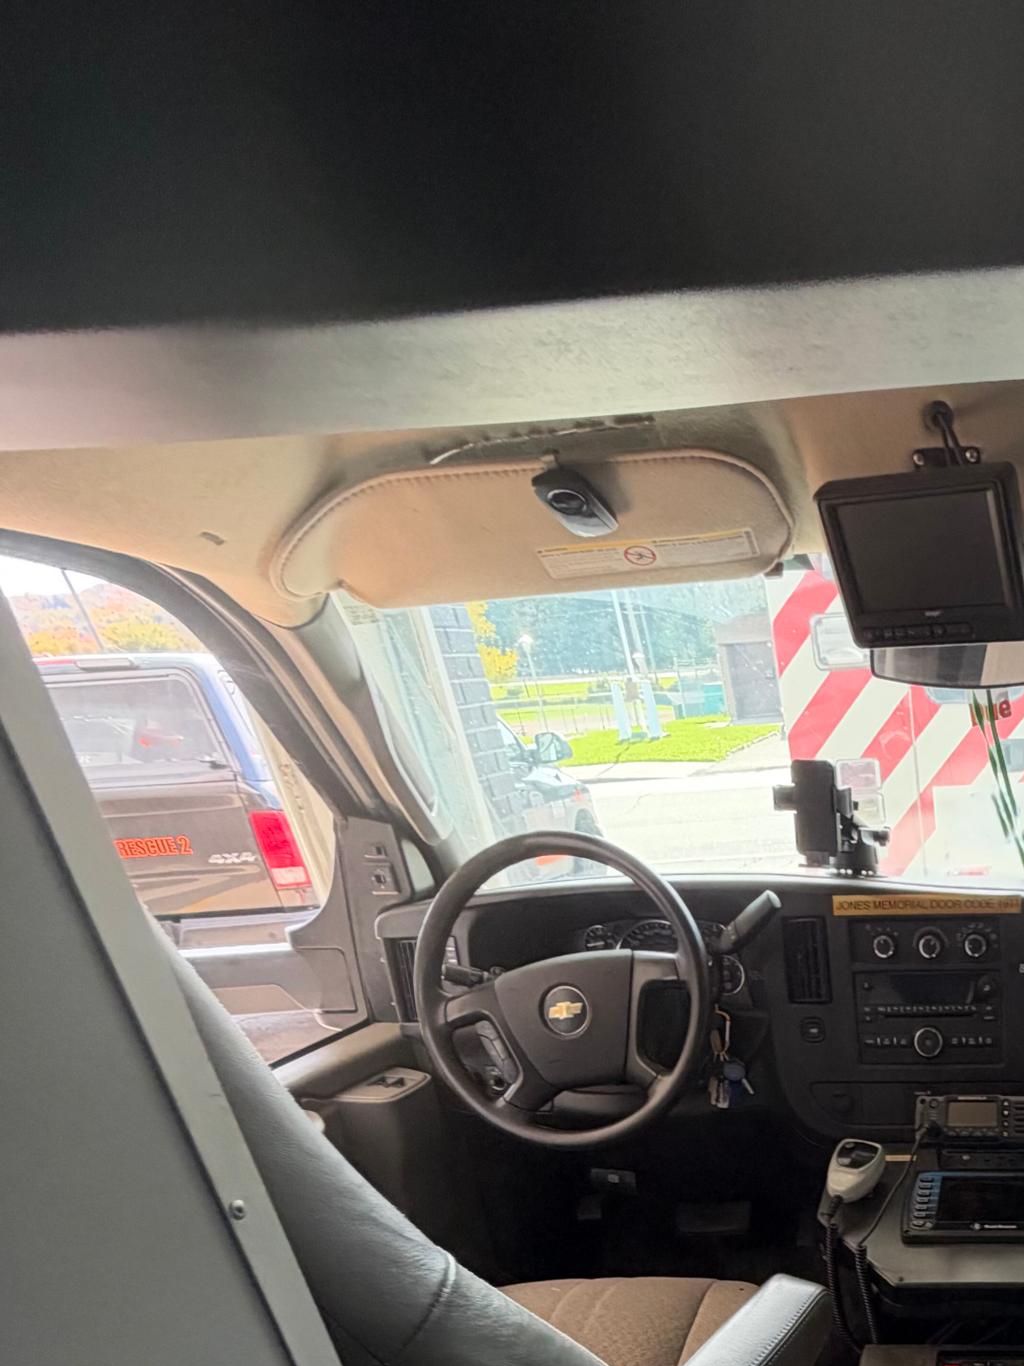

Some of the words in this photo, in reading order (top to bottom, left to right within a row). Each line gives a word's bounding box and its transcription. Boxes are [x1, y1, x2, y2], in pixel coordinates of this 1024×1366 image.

[113, 836, 178, 860] RESCUE
[175, 834, 193, 855] 2
[835, 900, 871, 911] JONES
[874, 899, 929, 910] MEMORIAL
[930, 899, 962, 910] DOOR
[964, 898, 996, 909] CODE
